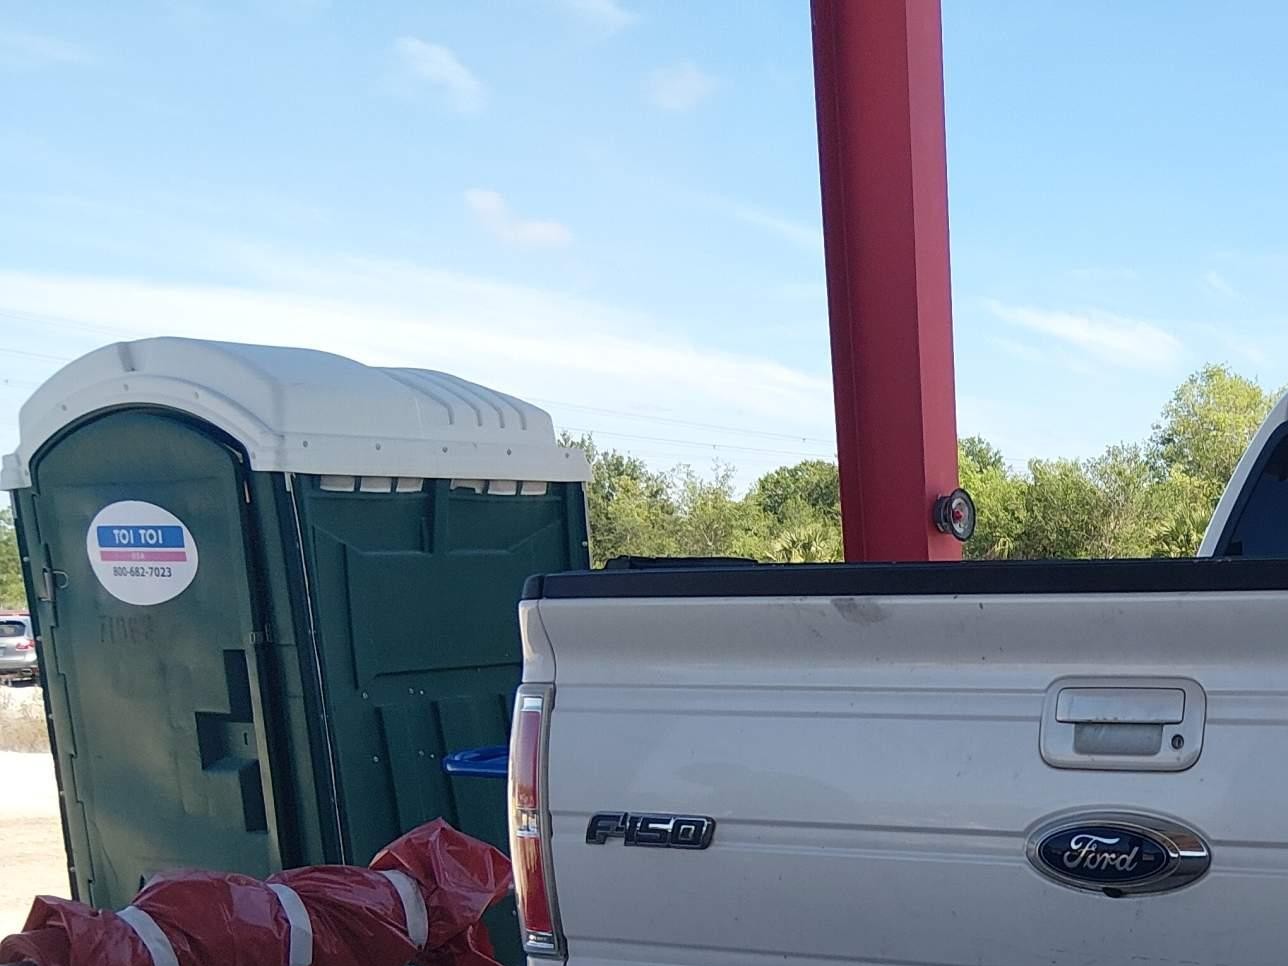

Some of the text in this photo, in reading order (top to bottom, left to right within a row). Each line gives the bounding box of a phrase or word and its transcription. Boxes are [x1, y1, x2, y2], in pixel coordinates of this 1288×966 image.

[112, 529, 163, 545] TOI TOI
[112, 566, 172, 578] 800-682-7023
[1062, 834, 1139, 872] Ford
